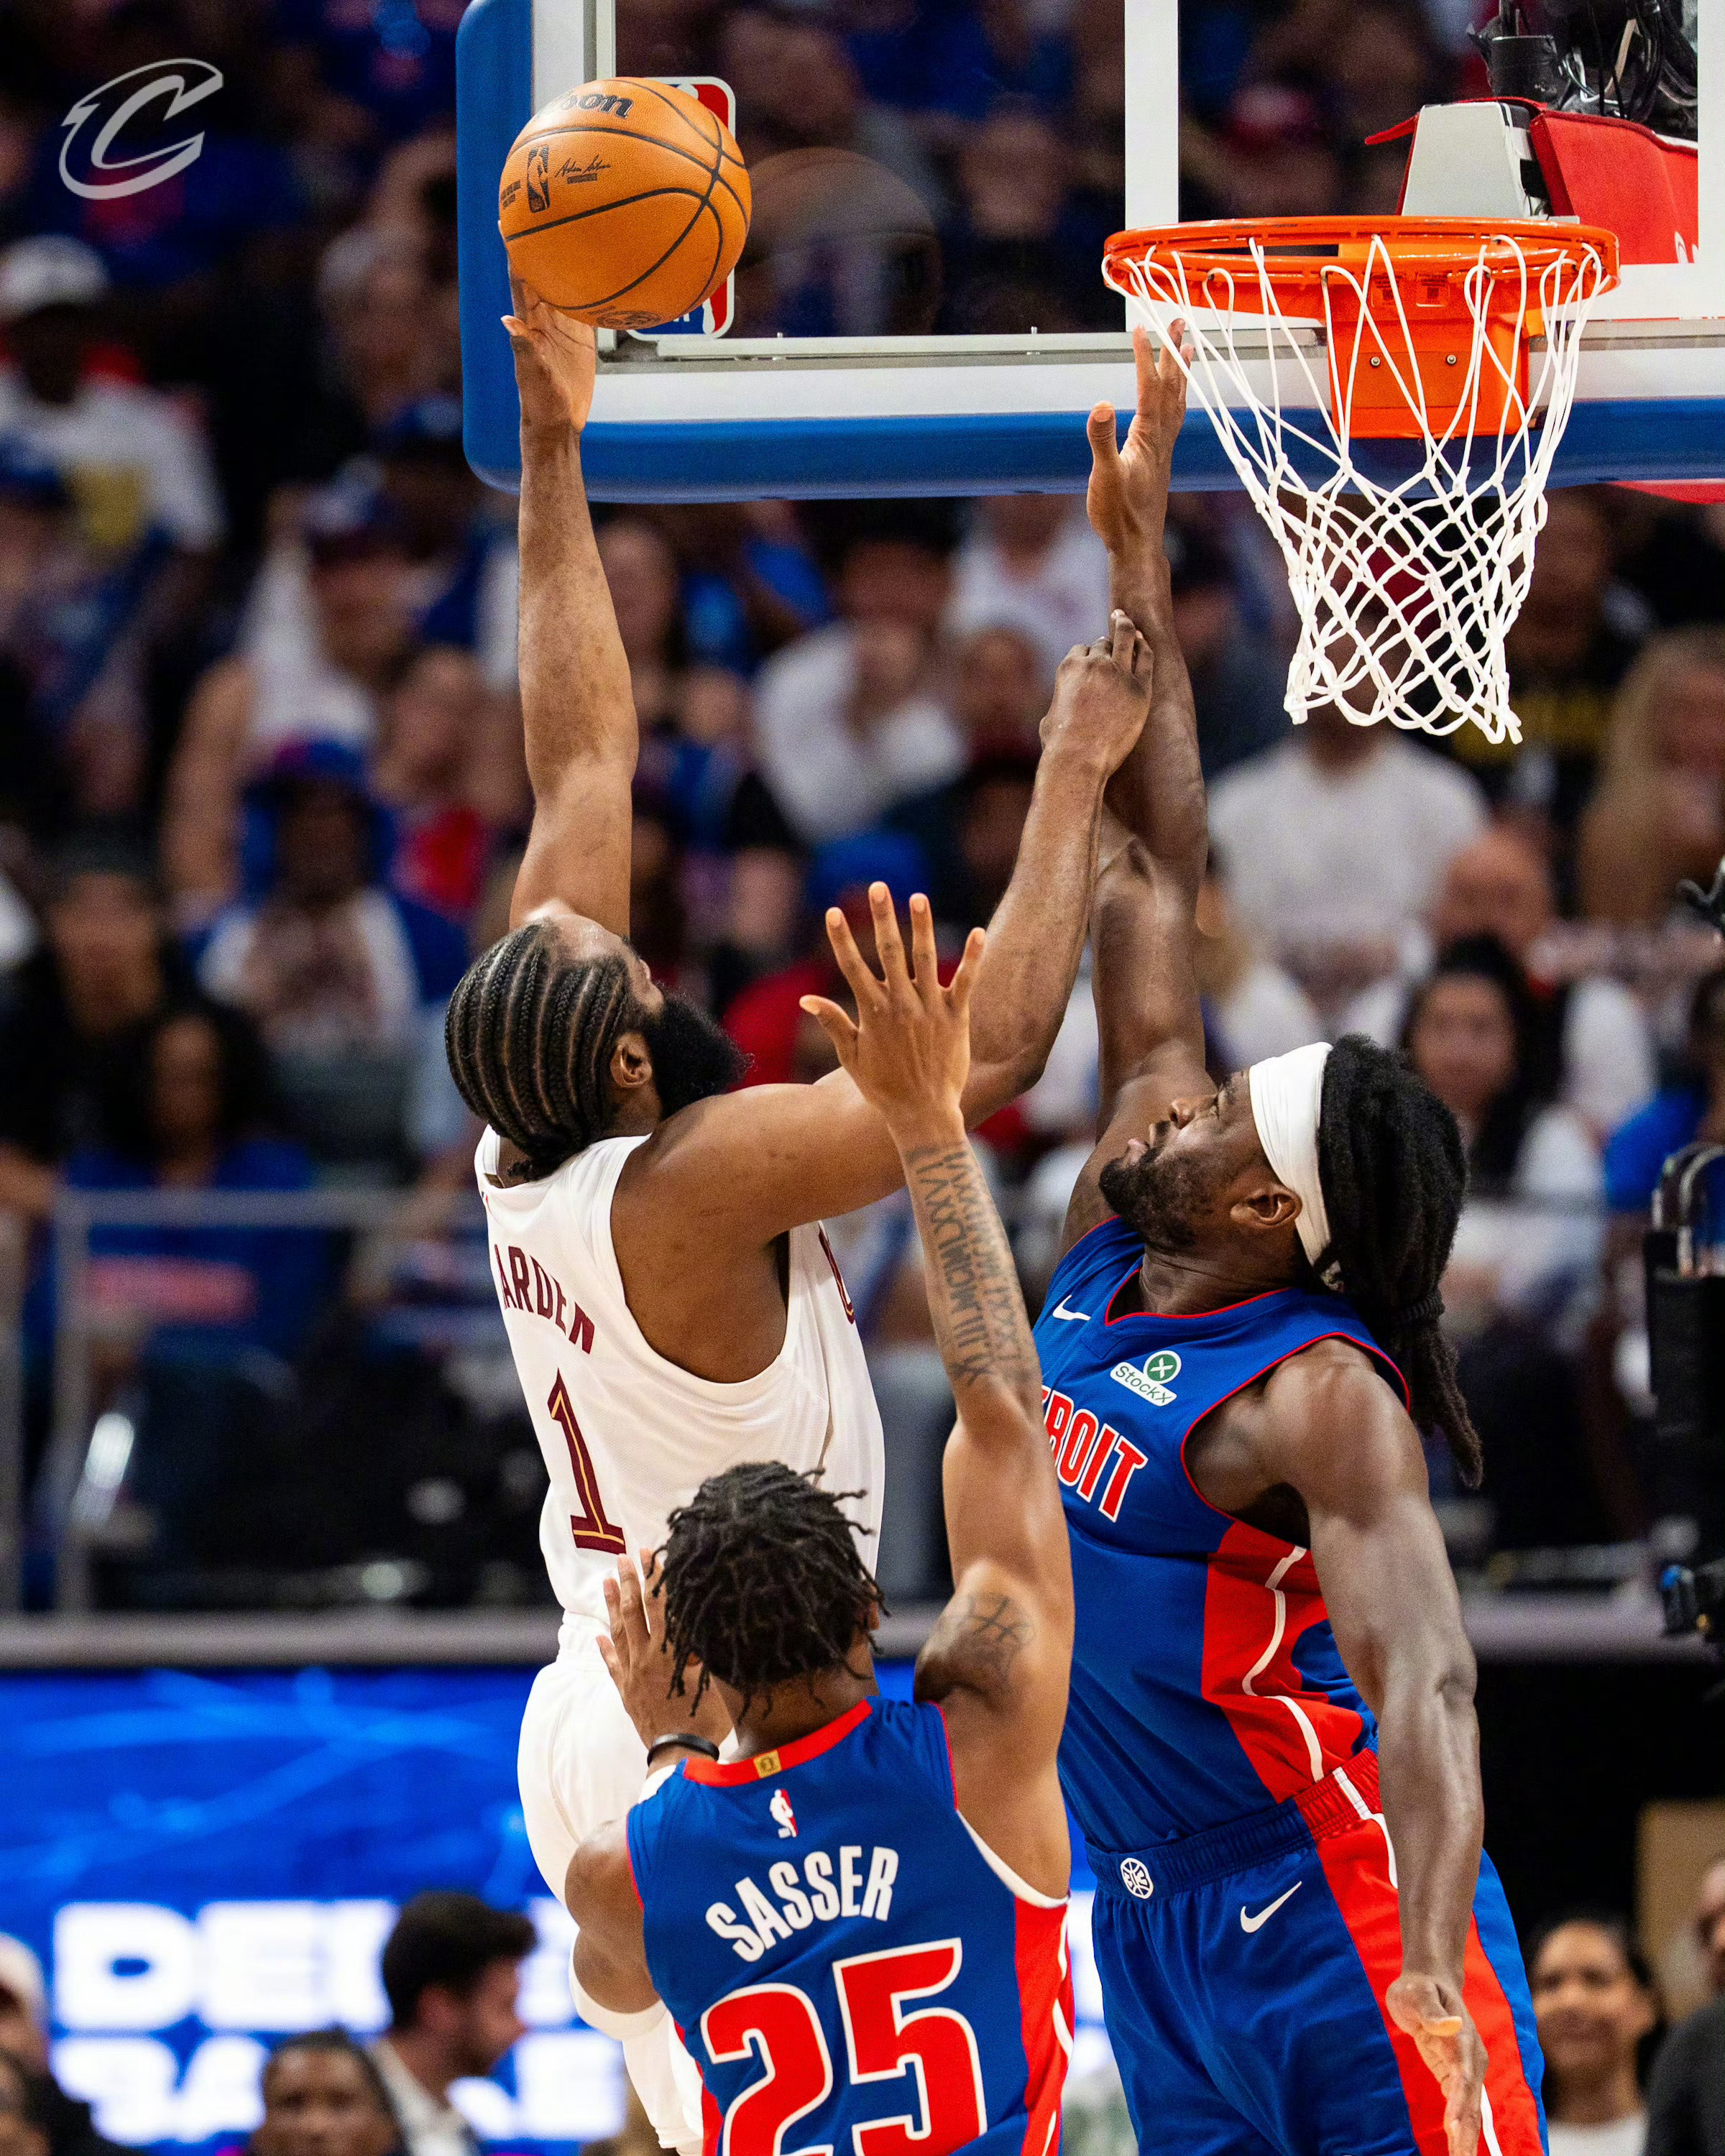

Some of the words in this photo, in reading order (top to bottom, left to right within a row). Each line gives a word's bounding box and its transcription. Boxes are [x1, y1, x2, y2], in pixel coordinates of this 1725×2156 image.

[494, 1243, 595, 1355] ARDEN
[548, 1368, 626, 1554] 1
[705, 1846, 898, 1962] SASSER
[700, 1938, 988, 2156] 25
